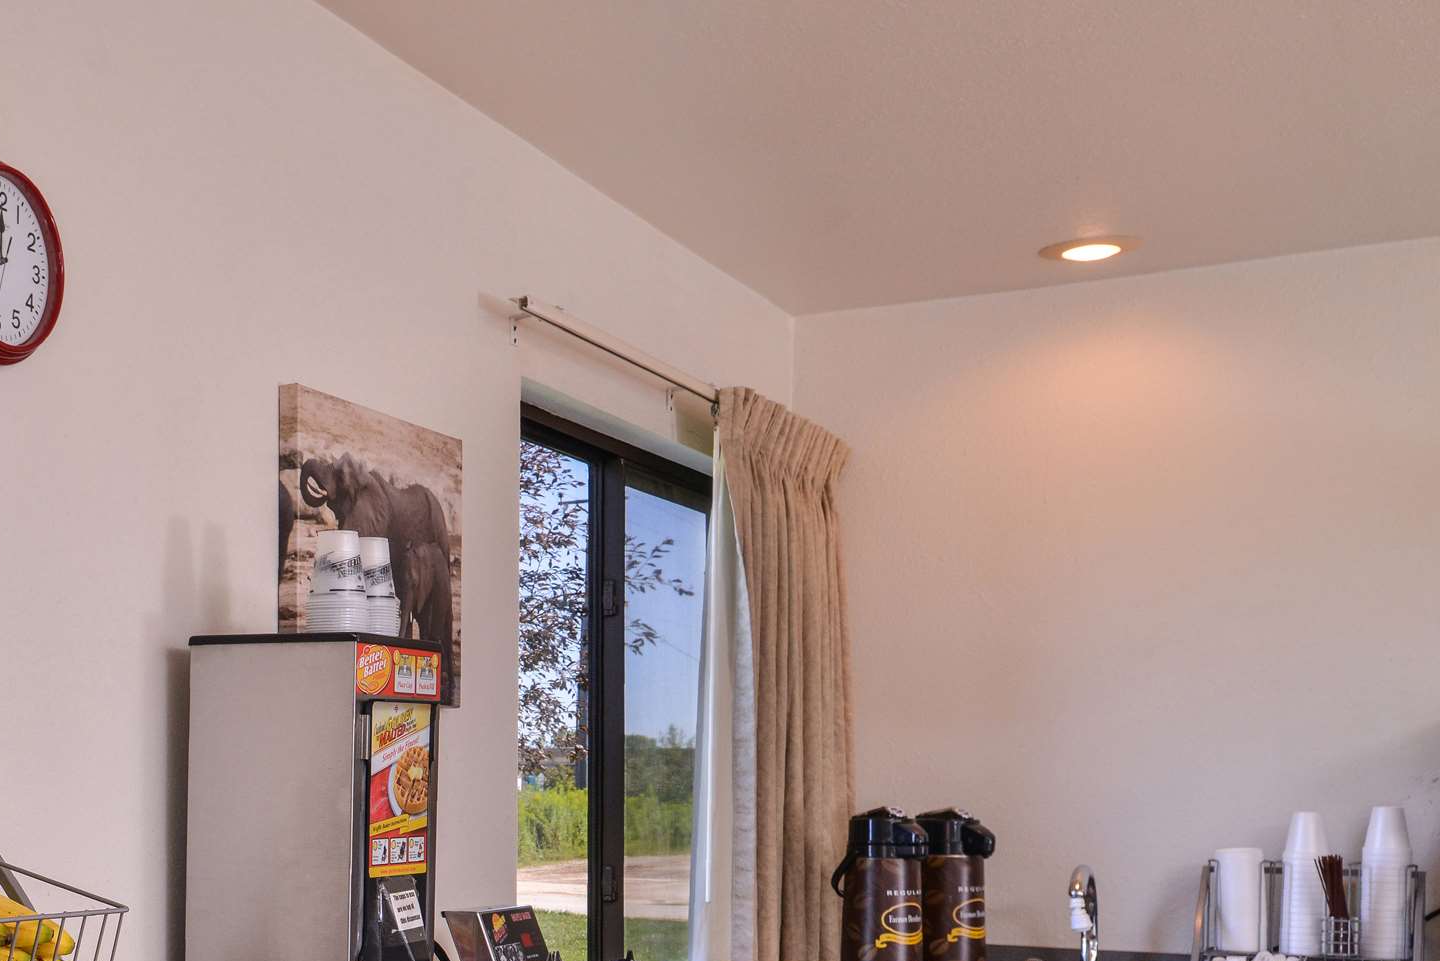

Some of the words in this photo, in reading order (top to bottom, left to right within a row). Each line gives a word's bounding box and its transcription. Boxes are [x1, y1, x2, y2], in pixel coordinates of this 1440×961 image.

[16, 205, 20, 224] 1
[27, 232, 36, 252] 2
[32, 265, 41, 285] 3
[25, 293, 35, 312] 4
[11, 309, 21, 329] 5
